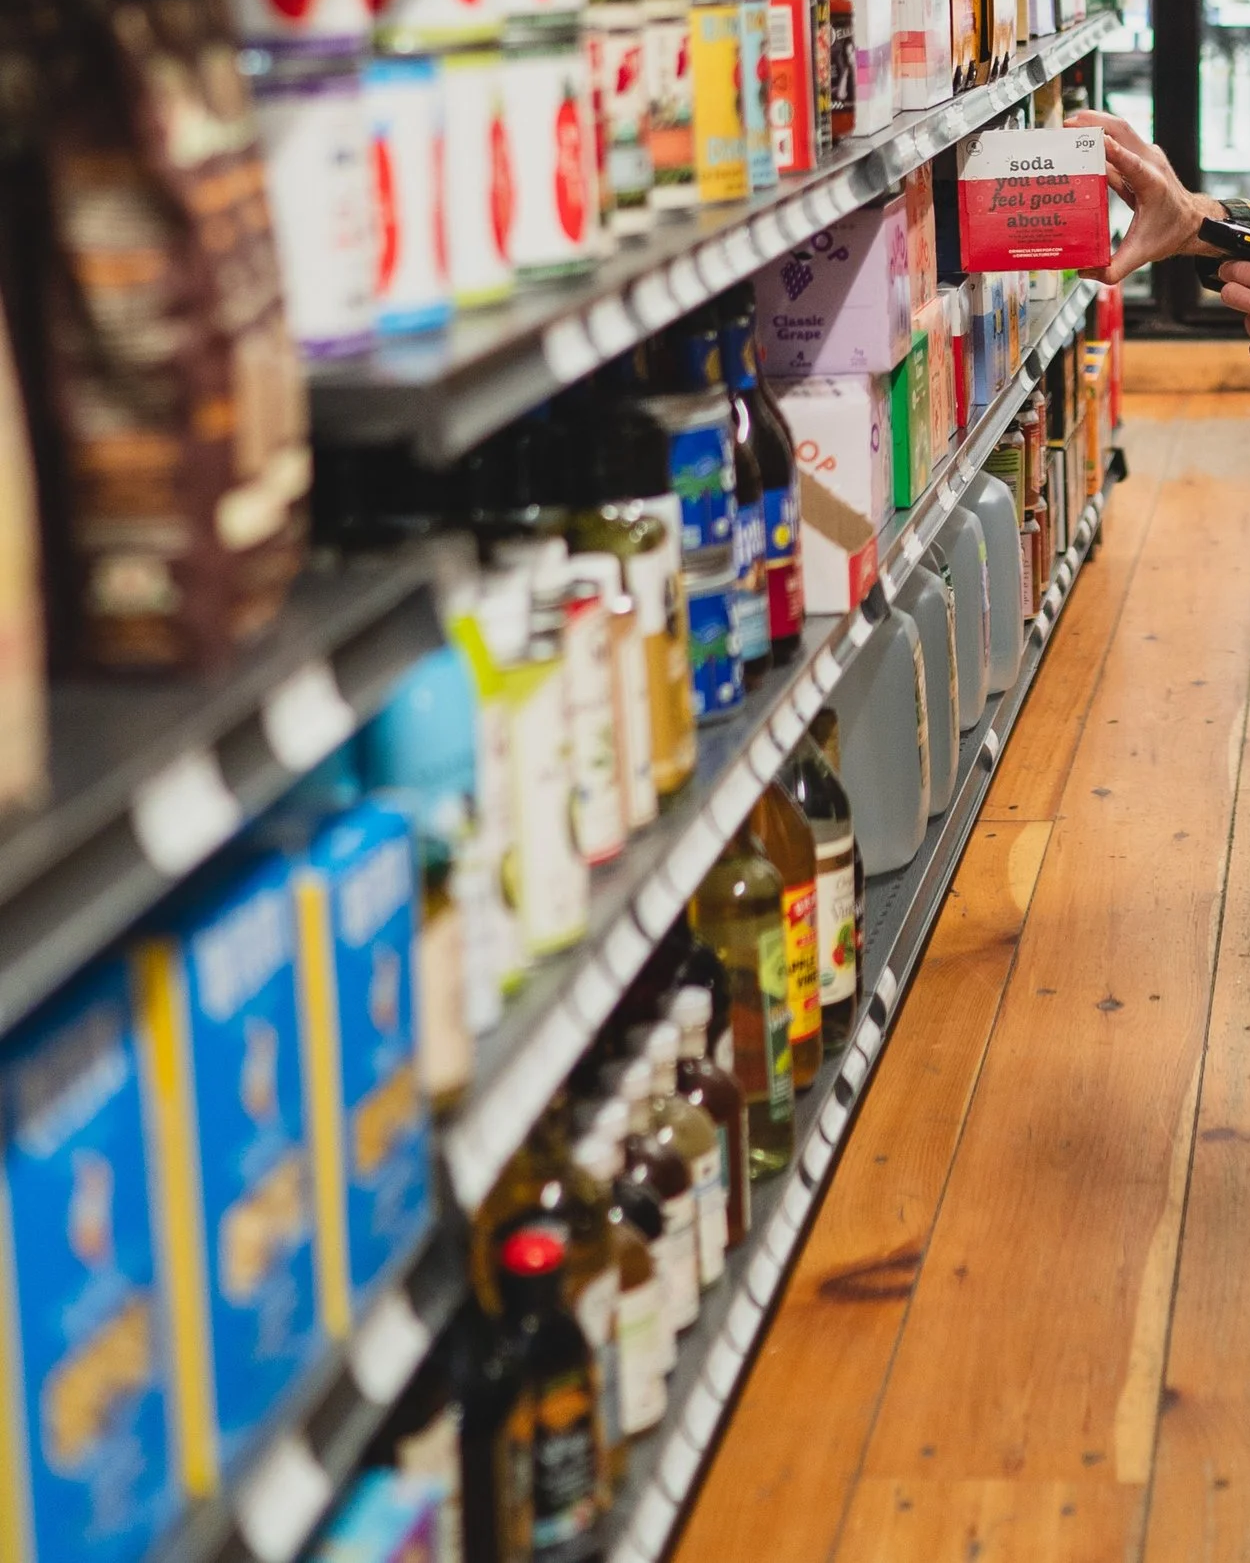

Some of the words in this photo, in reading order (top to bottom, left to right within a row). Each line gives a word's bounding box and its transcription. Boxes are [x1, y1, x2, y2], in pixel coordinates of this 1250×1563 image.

[1075, 139, 1096, 149] pop
[1009, 156, 1055, 172] soda
[995, 176, 1031, 192] you
[1035, 173, 1070, 187] can
[988, 193, 1026, 212] feel
[1029, 190, 1077, 210] good
[1007, 212, 1067, 228] about.
[772, 314, 825, 327] Classic
[776, 328, 822, 341] Grape
